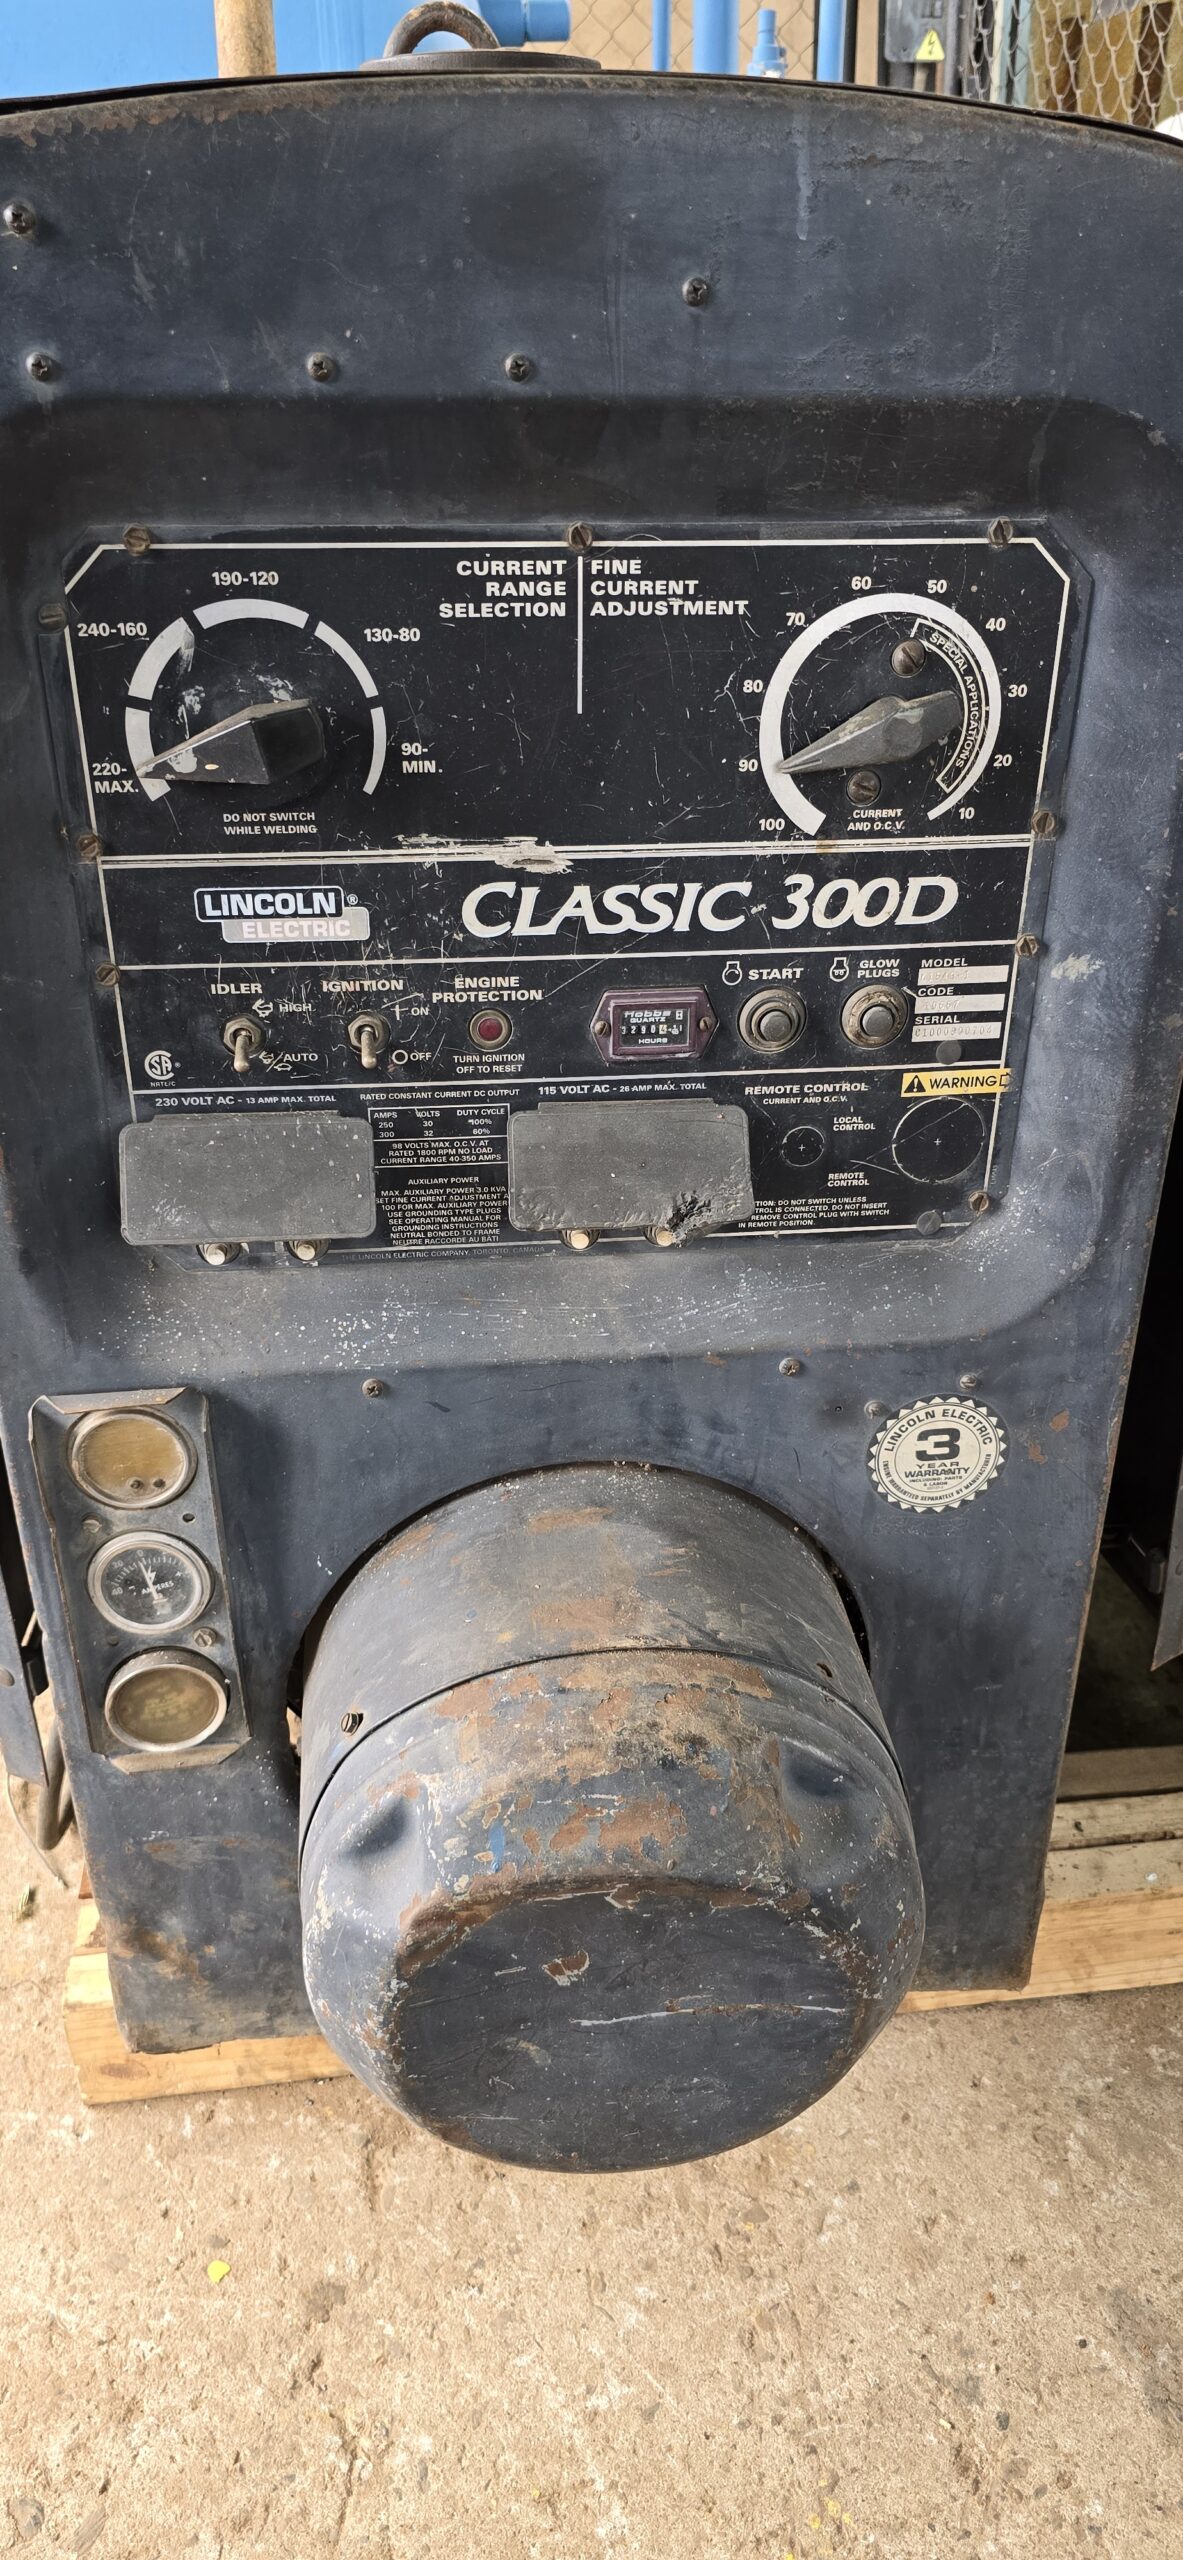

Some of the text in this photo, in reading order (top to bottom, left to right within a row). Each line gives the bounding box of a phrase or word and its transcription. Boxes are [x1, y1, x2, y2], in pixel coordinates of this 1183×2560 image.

[456, 560, 567, 576] CURRENT
[591, 560, 642, 574] FINE
[212, 571, 279, 586] 190-120
[851, 576, 872, 590] 60
[486, 582, 567, 596] RANGE
[591, 580, 698, 596] CURRENT
[927, 580, 947, 594] 50
[439, 602, 566, 618] SELECTION
[590, 600, 748, 616] ADJUSTMENT
[786, 612, 805, 626] 70
[986, 618, 1006, 631] 40
[77, 622, 148, 636] 240-160
[364, 628, 420, 642] 130-80
[743, 680, 763, 692] 80
[1008, 684, 1028, 698] 30
[930, 633, 980, 768] SPECIAL APPLICATIONS
[400, 742, 428, 756] 90-
[402, 760, 442, 774] MIN.
[738, 759, 758, 772] 90
[994, 754, 1012, 767] 20
[92, 762, 127, 776] 220-
[94, 780, 139, 794] MAX.
[223, 812, 316, 823] DO NOT SWITCH
[853, 809, 903, 818] CURRENT
[958, 808, 974, 820] 10
[224, 824, 318, 836] WHILE WELDING
[758, 818, 785, 831] 100
[848, 820, 905, 831] AND O.C.V.
[204, 892, 336, 916] LINCOLN
[461, 874, 958, 938] CLASSIC 300D
[242, 920, 350, 938] ELECTRIC
[860, 959, 899, 968] GLOW
[921, 958, 968, 968] MODEL
[748, 968, 803, 980] START
[858, 968, 899, 978] PLUGS
[210, 983, 262, 994] IDLER
[322, 980, 404, 992] IGNITION
[454, 976, 520, 988] ENGINE
[432, 989, 542, 1003] PROTECTION
[918, 986, 954, 996] CODE
[279, 1004, 312, 1012] HIGH
[411, 1007, 429, 1016] ON
[915, 1015, 960, 1024] SERIAL
[284, 1053, 318, 1062] AUTO
[410, 1052, 432, 1061] OFF
[453, 1054, 525, 1063] TURN IGNITION
[456, 1064, 522, 1074] OFF TO RESET
[538, 1086, 556, 1094] 115
[561, 1086, 590, 1094] VOLT
[593, 1084, 610, 1093] AC
[930, 1076, 998, 1089] WARNING
[434, 1090, 471, 1098] CURRENT
[744, 1083, 868, 1096] REMOTE CONTROL
[155, 1098, 178, 1107] 230
[182, 1096, 213, 1106] VOLT
[216, 1096, 235, 1105] AC
[833, 1123, 876, 1131] CONTROL
[828, 1179, 870, 1187] CONTROL
[884, 1409, 992, 1452] LINCOLN ELECTRIC
[916, 1428, 960, 1462] 3
[904, 1467, 970, 1478] WARRANTY
[916, 1462, 959, 1470] YEAR
